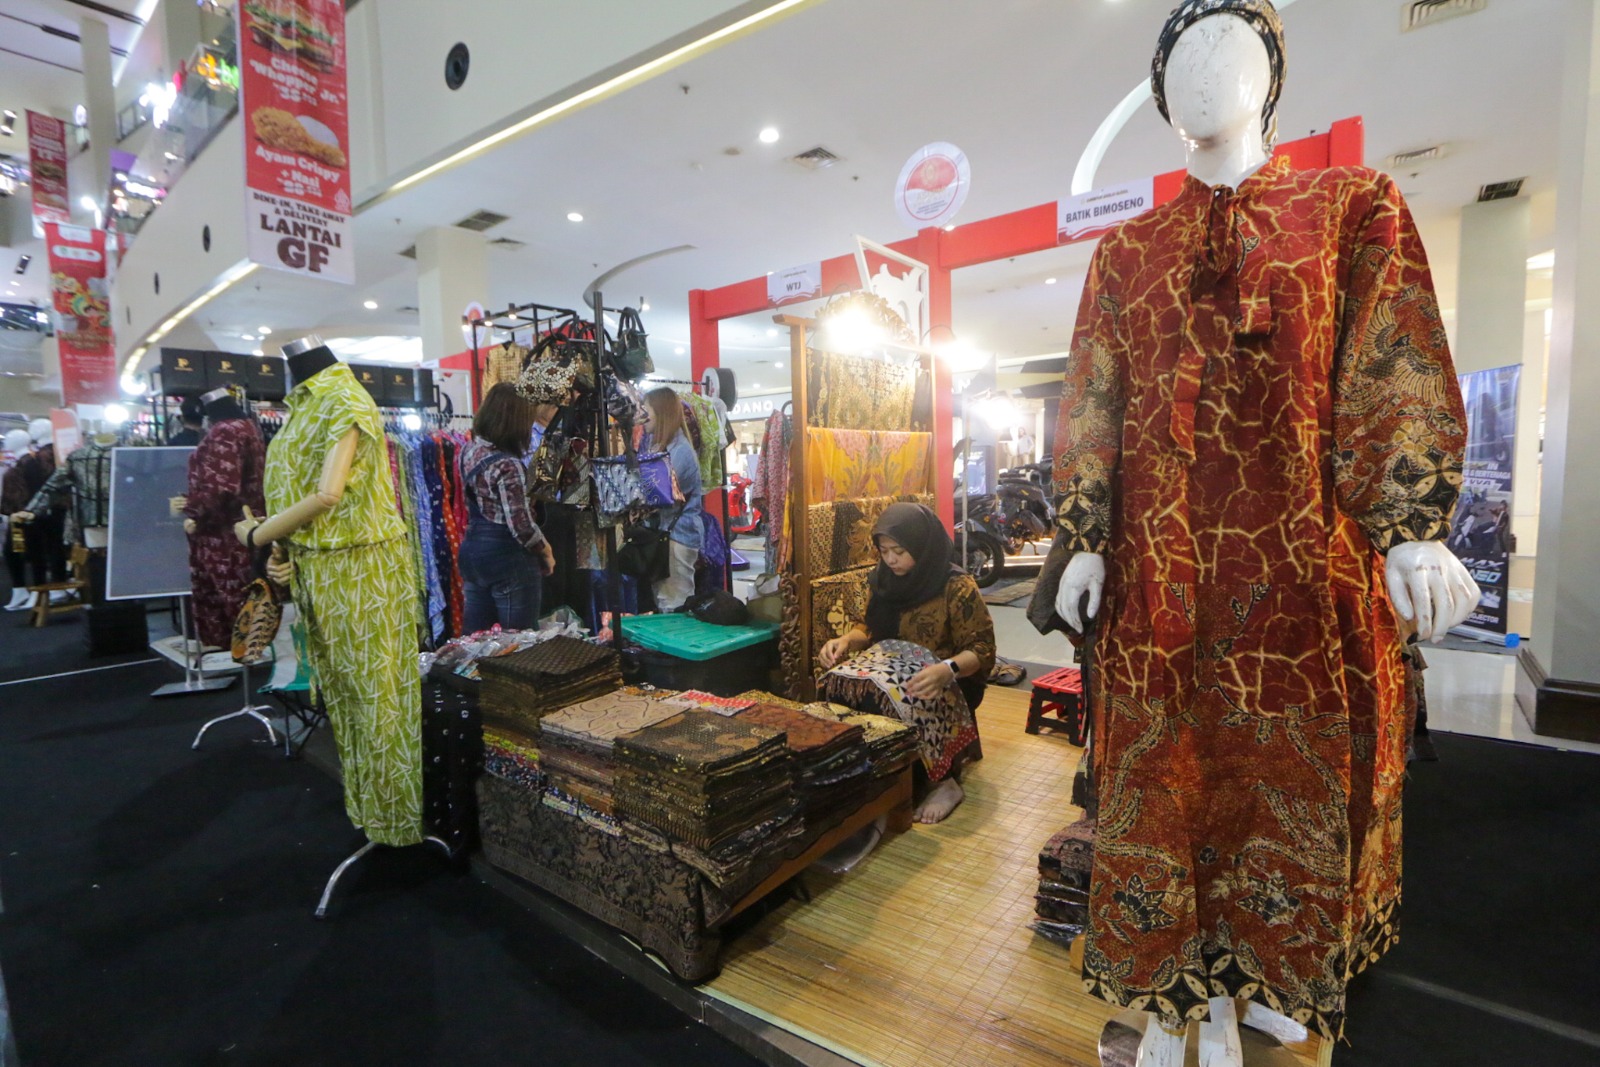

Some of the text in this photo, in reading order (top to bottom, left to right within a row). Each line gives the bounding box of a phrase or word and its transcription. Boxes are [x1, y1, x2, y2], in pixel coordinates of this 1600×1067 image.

[255, 145, 340, 184] Ayam Crispy
[291, 169, 320, 189] Nasi
[284, 209, 328, 227] DELIVERY
[1066, 197, 1145, 224] BATIK BIMOSENO
[260, 213, 341, 249] LANTAI
[277, 236, 330, 273] GF
[786, 281, 802, 292] WTJ
[1470, 569, 1502, 583] NEO
